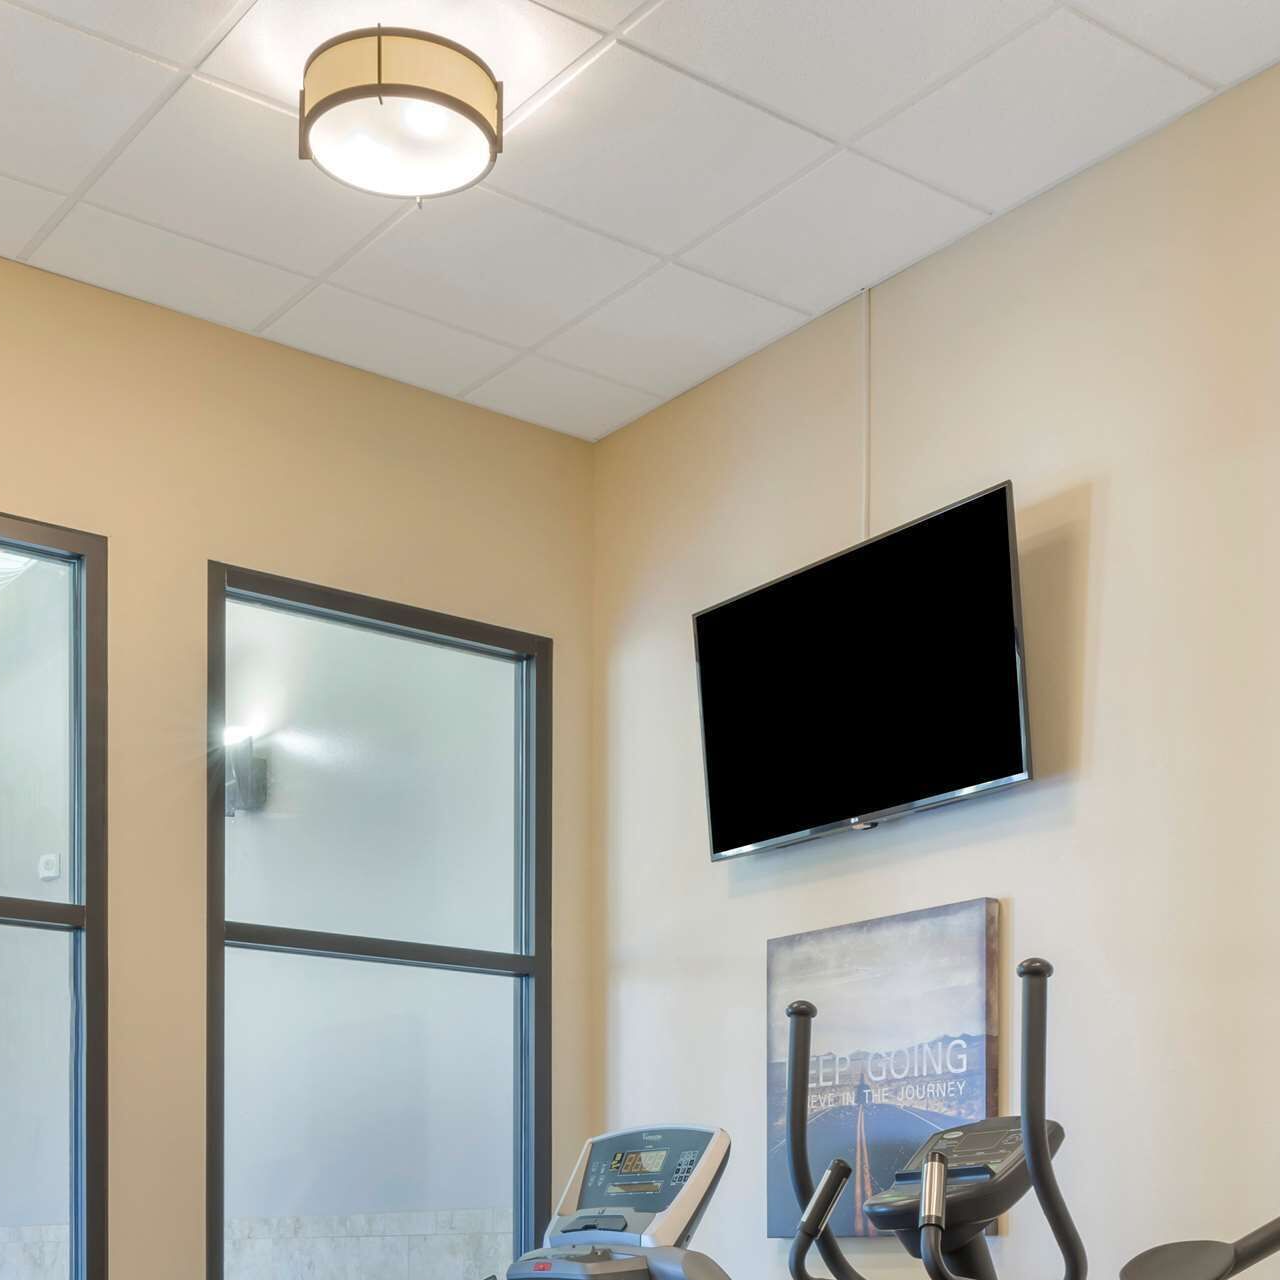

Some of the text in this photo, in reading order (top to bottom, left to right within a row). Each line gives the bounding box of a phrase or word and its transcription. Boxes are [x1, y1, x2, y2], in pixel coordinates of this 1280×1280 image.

[787, 1039, 968, 1088] EEP GOING
[841, 1091, 856, 1105] IN
[863, 1087, 889, 1104] THE
[897, 1080, 967, 1101] JOURNEY
